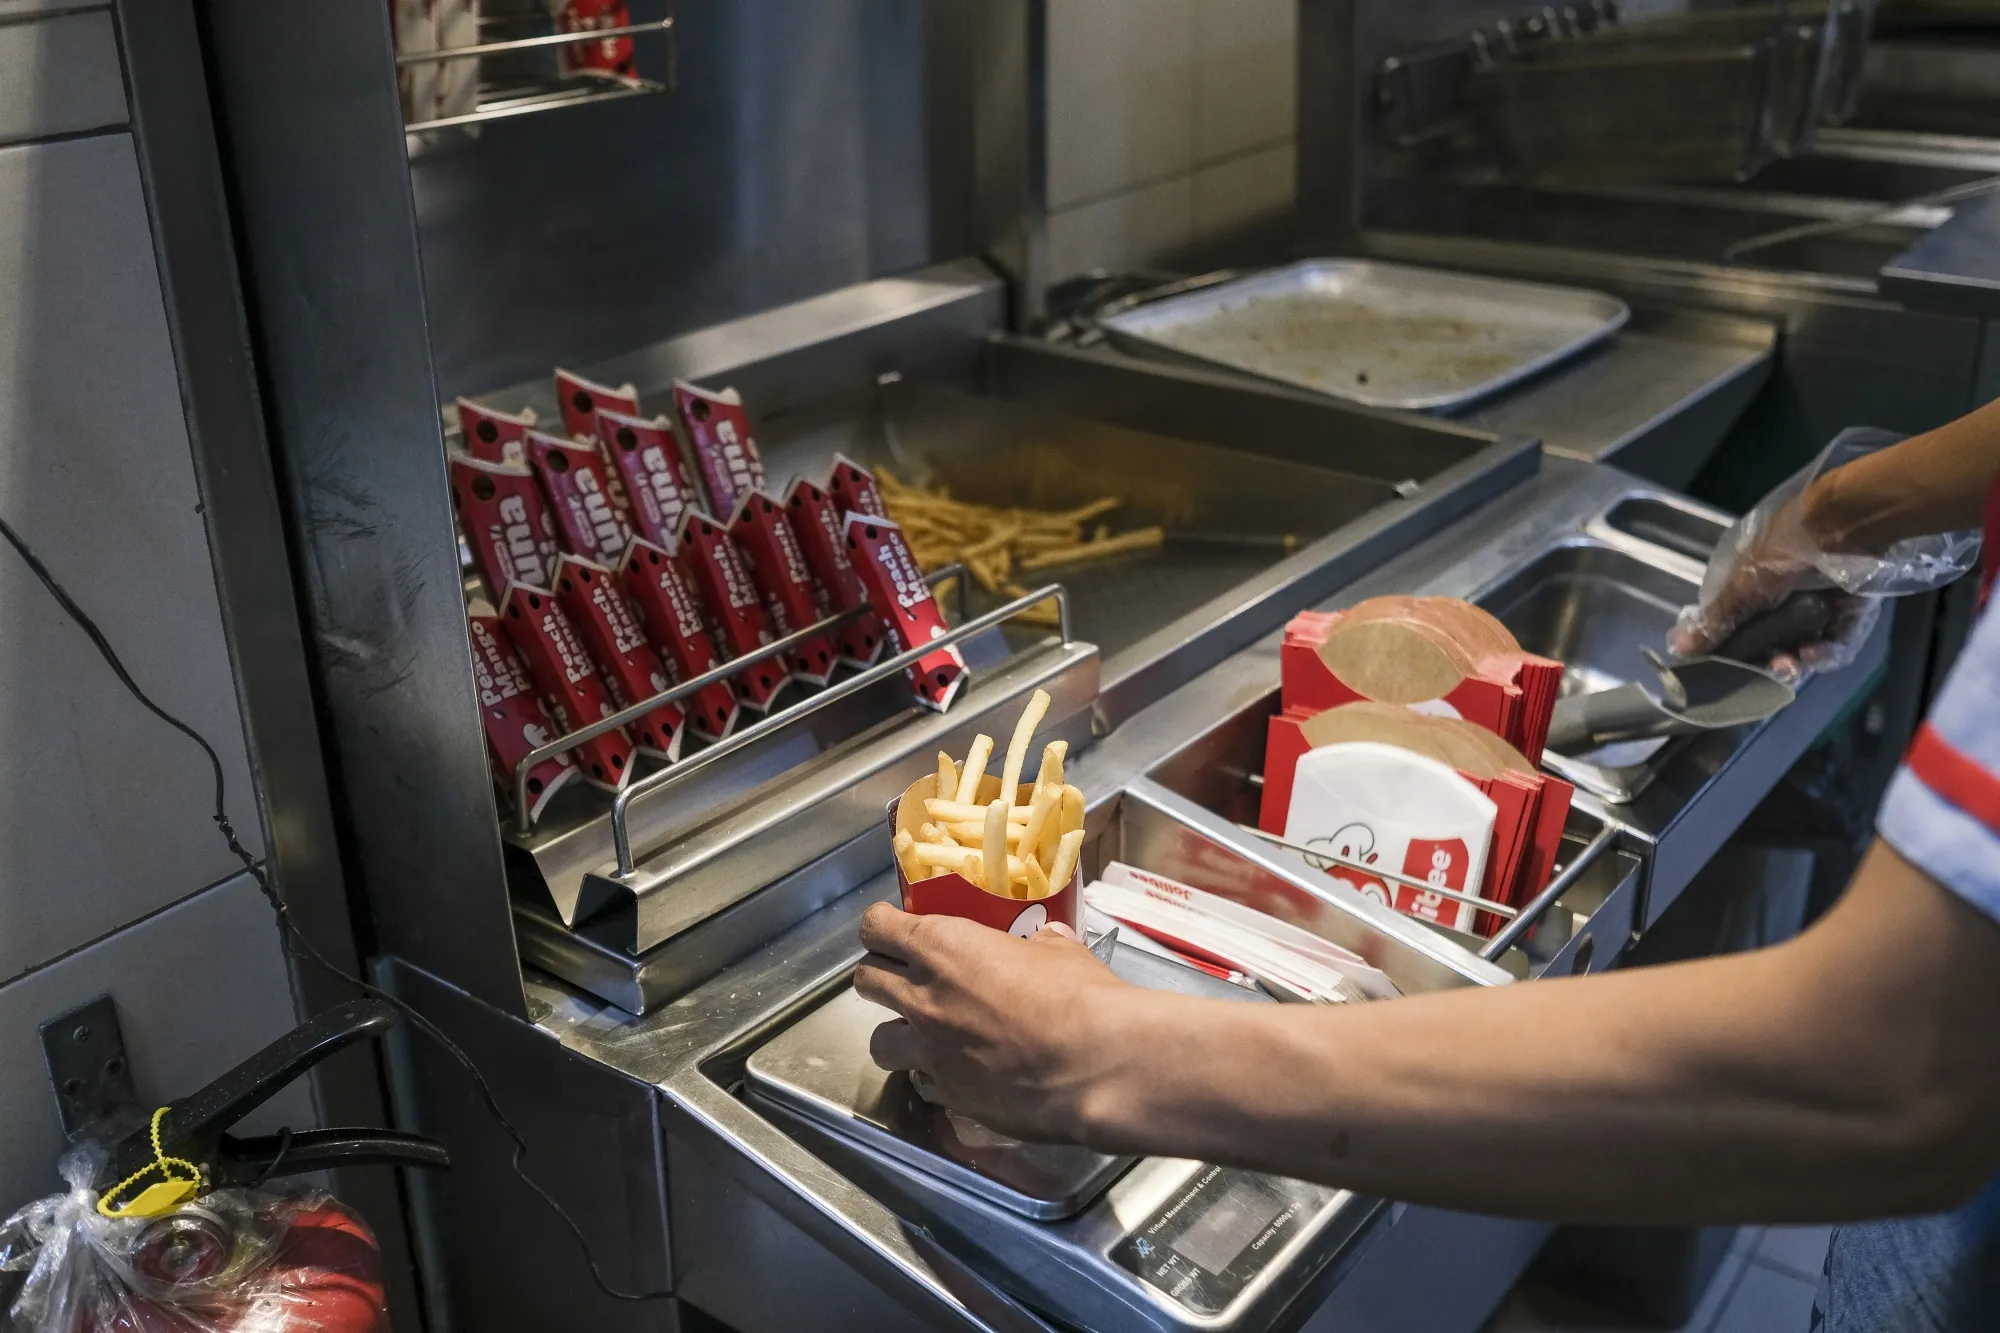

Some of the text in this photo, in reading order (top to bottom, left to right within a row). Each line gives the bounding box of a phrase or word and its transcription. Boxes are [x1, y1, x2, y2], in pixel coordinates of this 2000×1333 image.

[717, 421, 752, 496] una
[500, 496, 545, 584] una
[774, 522, 801, 584] Peach
[889, 532, 926, 602] Mango
[661, 572, 692, 638] Peach
[713, 544, 743, 608] Peach
[878, 545, 914, 607] Peach
[550, 601, 591, 676] Mango
[593, 587, 632, 653] Peach
[600, 575, 641, 648] Mango
[472, 621, 519, 699] Mango
[473, 645, 502, 707] Pea
[543, 614, 581, 684] Peach
[1411, 849, 1452, 920] ibee
[1148, 1216, 1168, 1235] Virtual
[1164, 1186, 1200, 1219] Measurement
[1201, 1165, 1222, 1184] Control
[1156, 1254, 1180, 1277] NET WT
[1251, 1226, 1277, 1250] Capacity:
[1170, 1267, 1201, 1297] GROSS WT
